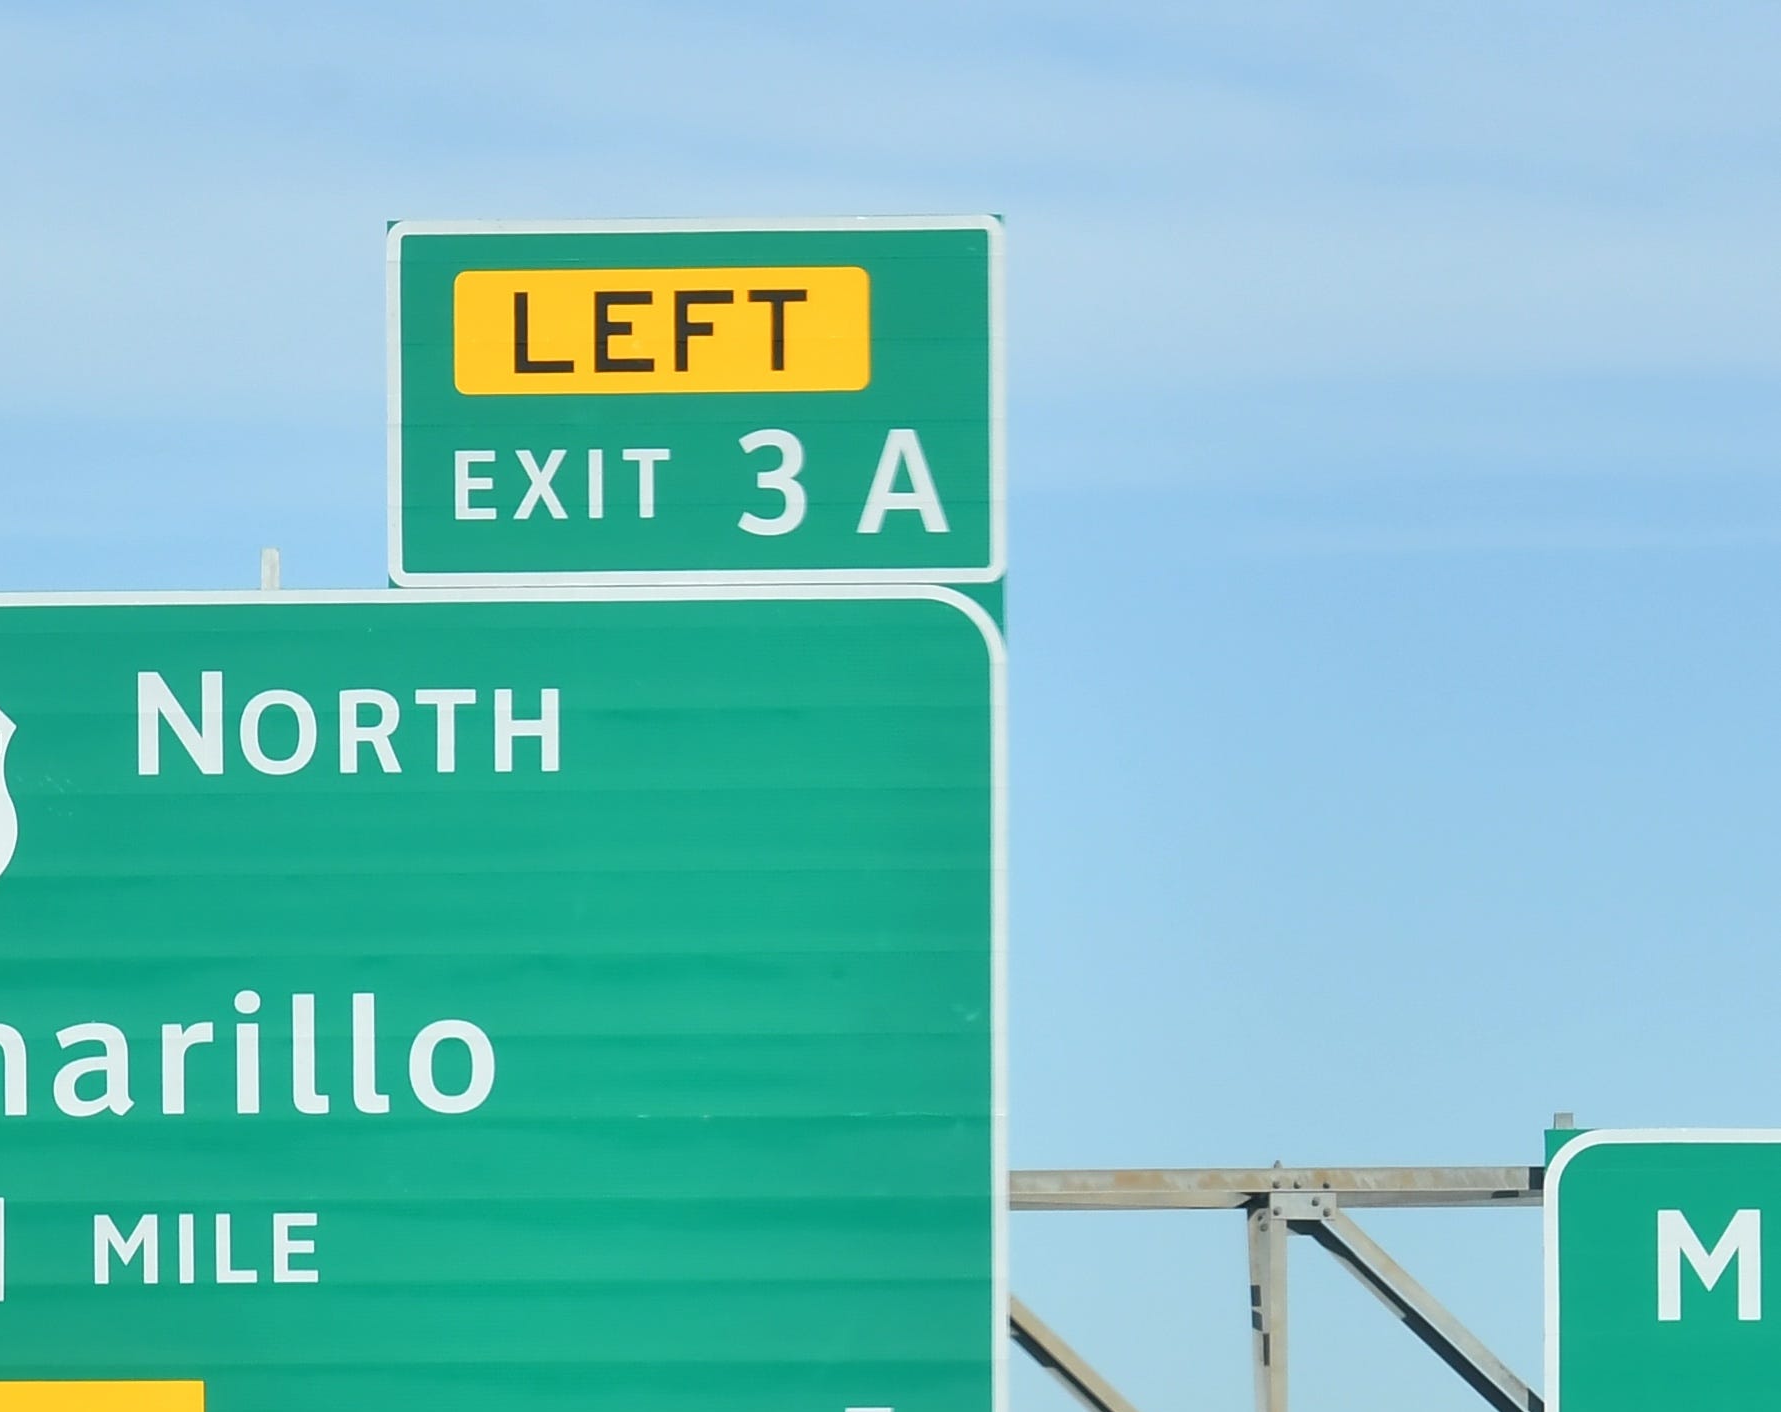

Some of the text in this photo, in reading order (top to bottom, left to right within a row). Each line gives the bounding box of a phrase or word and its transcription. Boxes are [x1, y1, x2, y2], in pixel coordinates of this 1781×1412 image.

[514, 289, 807, 374] LEFT
[454, 449, 670, 520] EXIT
[137, 670, 560, 776] NORTH
[94, 1212, 319, 1284] MILE
[1658, 1209, 1761, 1321] M
